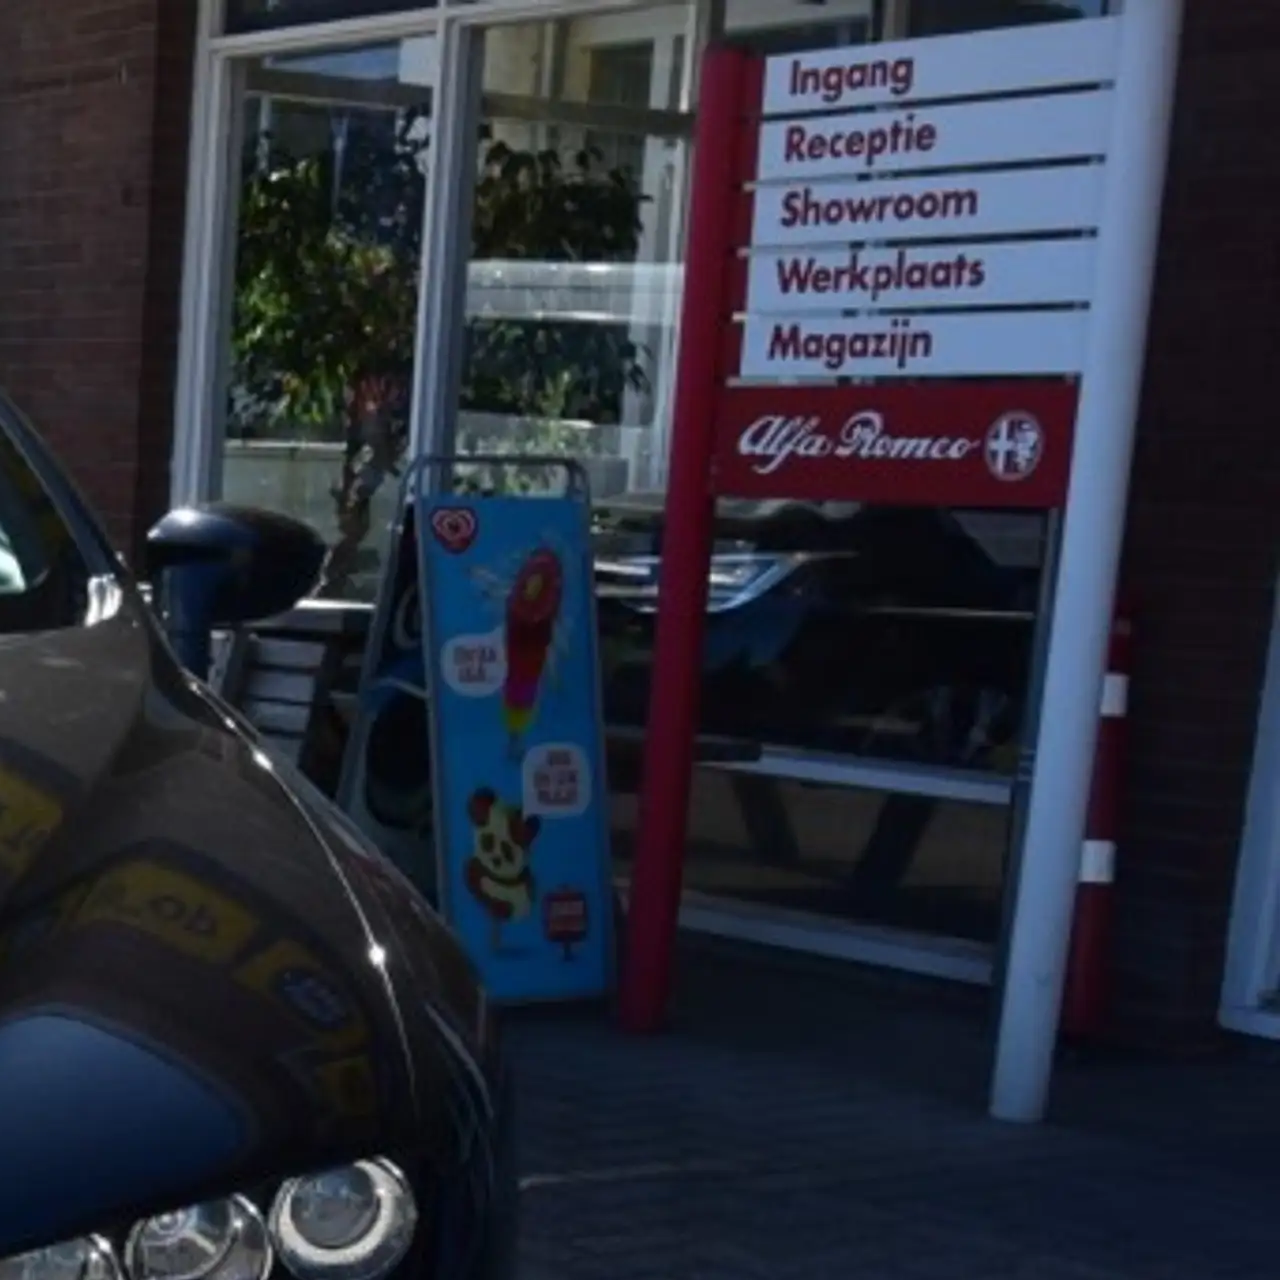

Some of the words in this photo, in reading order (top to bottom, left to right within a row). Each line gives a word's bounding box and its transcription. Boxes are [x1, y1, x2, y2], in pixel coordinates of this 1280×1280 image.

[789, 56, 914, 102] Ingang
[784, 115, 937, 165] Receptie
[780, 186, 979, 228] Showroom
[776, 250, 986, 301] Werkplaats
[767, 319, 933, 369] Magazijn
[738, 415, 828, 475] Alfa
[833, 411, 978, 459] Romeo
